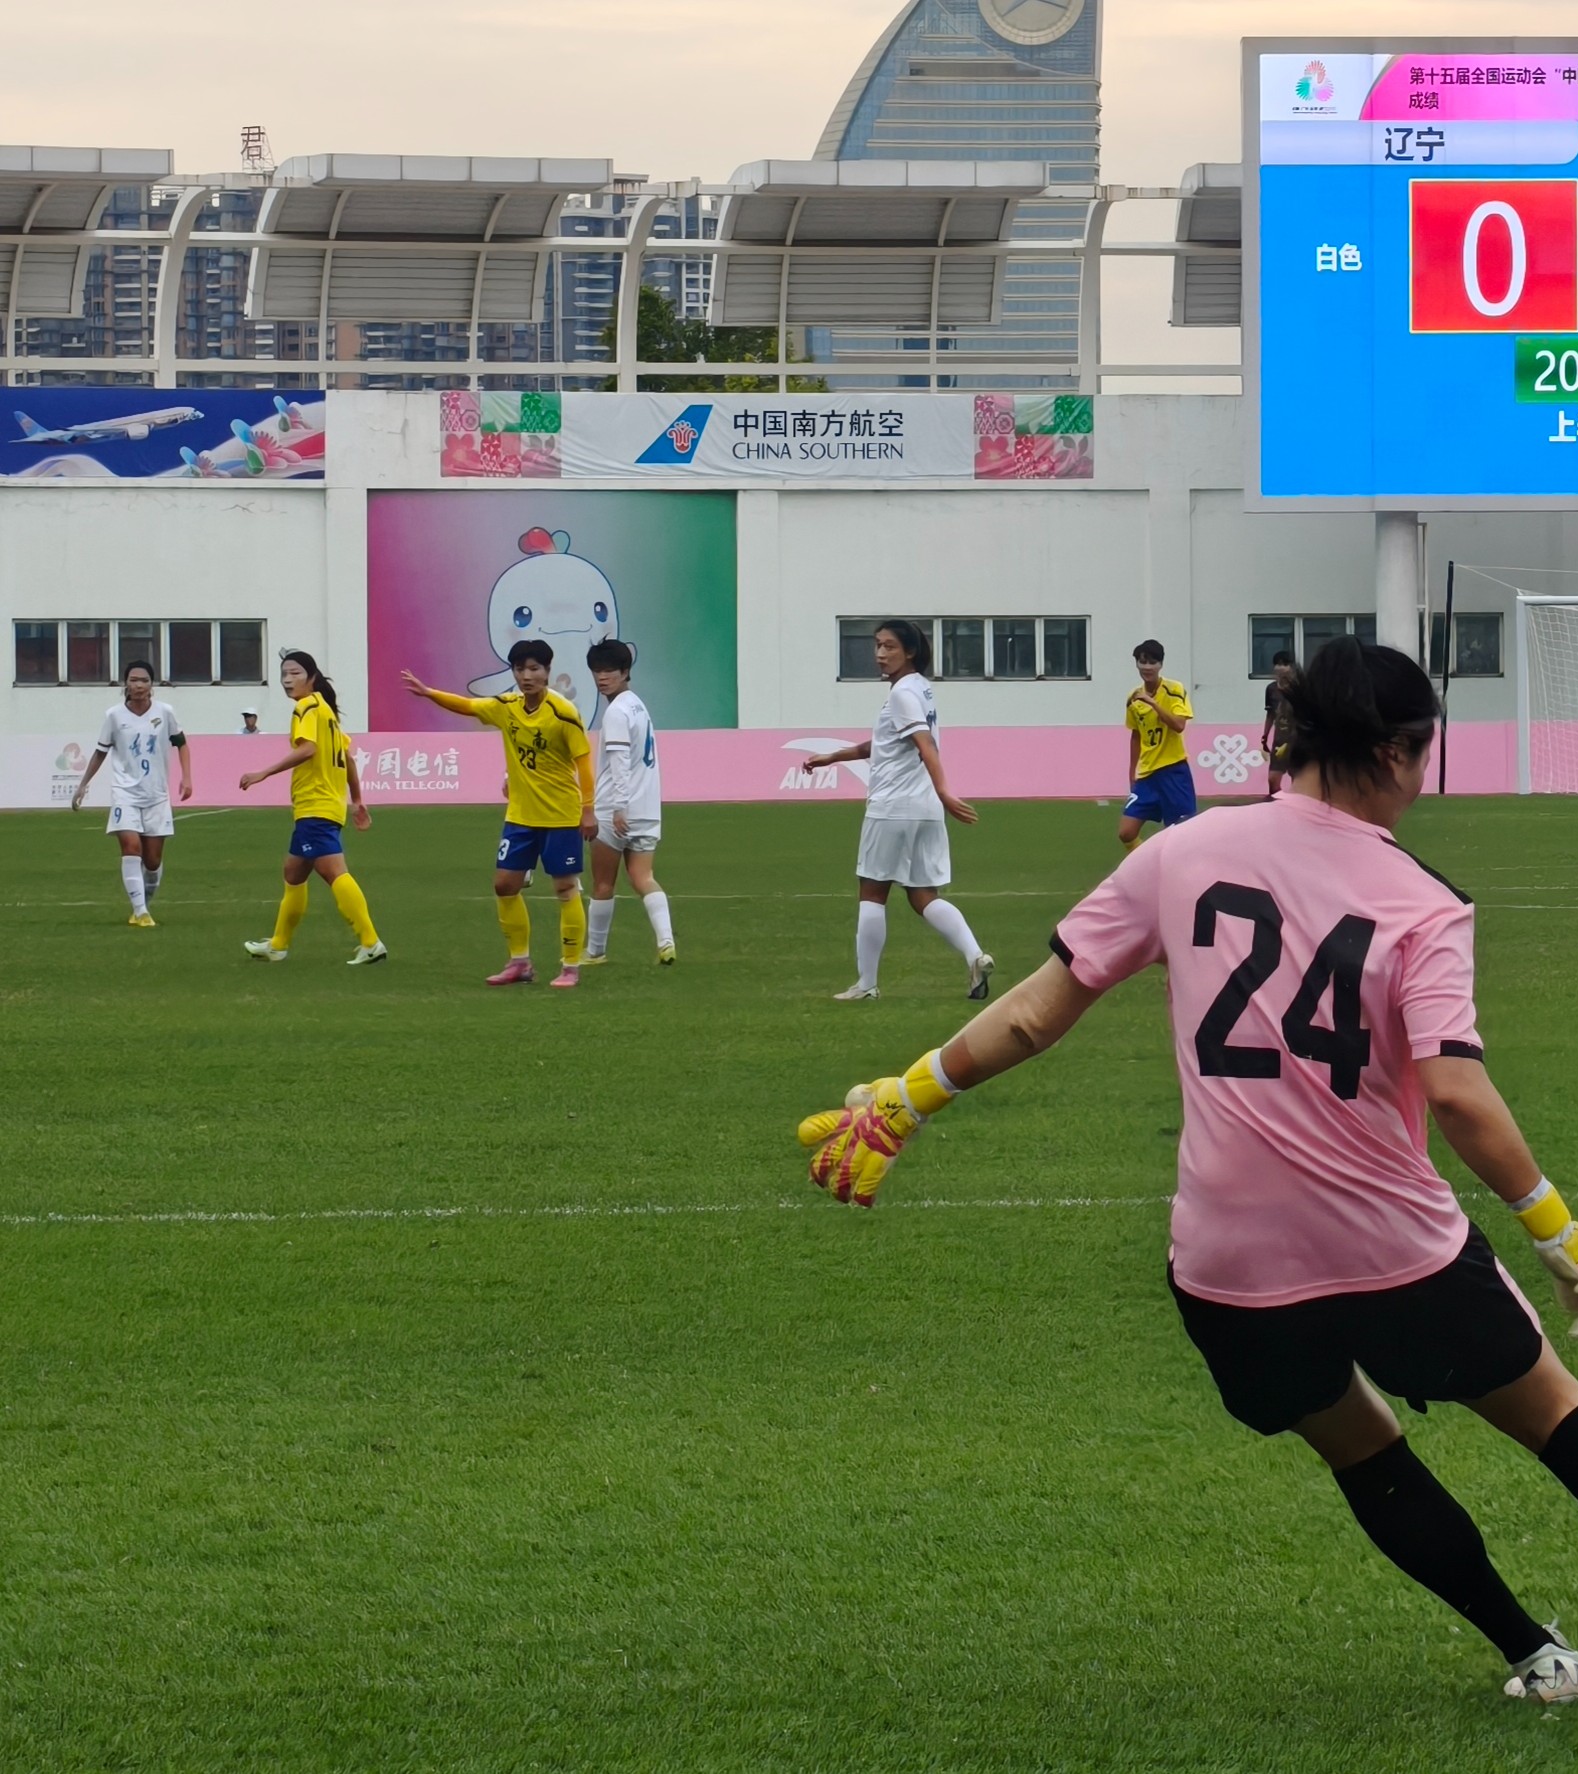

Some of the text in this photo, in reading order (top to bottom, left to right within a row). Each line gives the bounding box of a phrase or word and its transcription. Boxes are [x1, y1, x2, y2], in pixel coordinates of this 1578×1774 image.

[1408, 91, 1440, 110] 成绩
[1384, 126, 1446, 162] 辽宁
[1315, 243, 1363, 272] 白色
[1462, 200, 1526, 317] 0
[733, 408, 905, 439] 中国南方航空
[732, 441, 904, 460] CHINA SOUTHERN
[1147, 727, 1163, 747] 27
[141, 758, 150, 777] 9
[517, 745, 537, 771] 23
[394, 780, 459, 790] TELECOM
[779, 765, 838, 790] ANTA
[114, 807, 122, 824] 9
[1192, 880, 1377, 1100] 24
